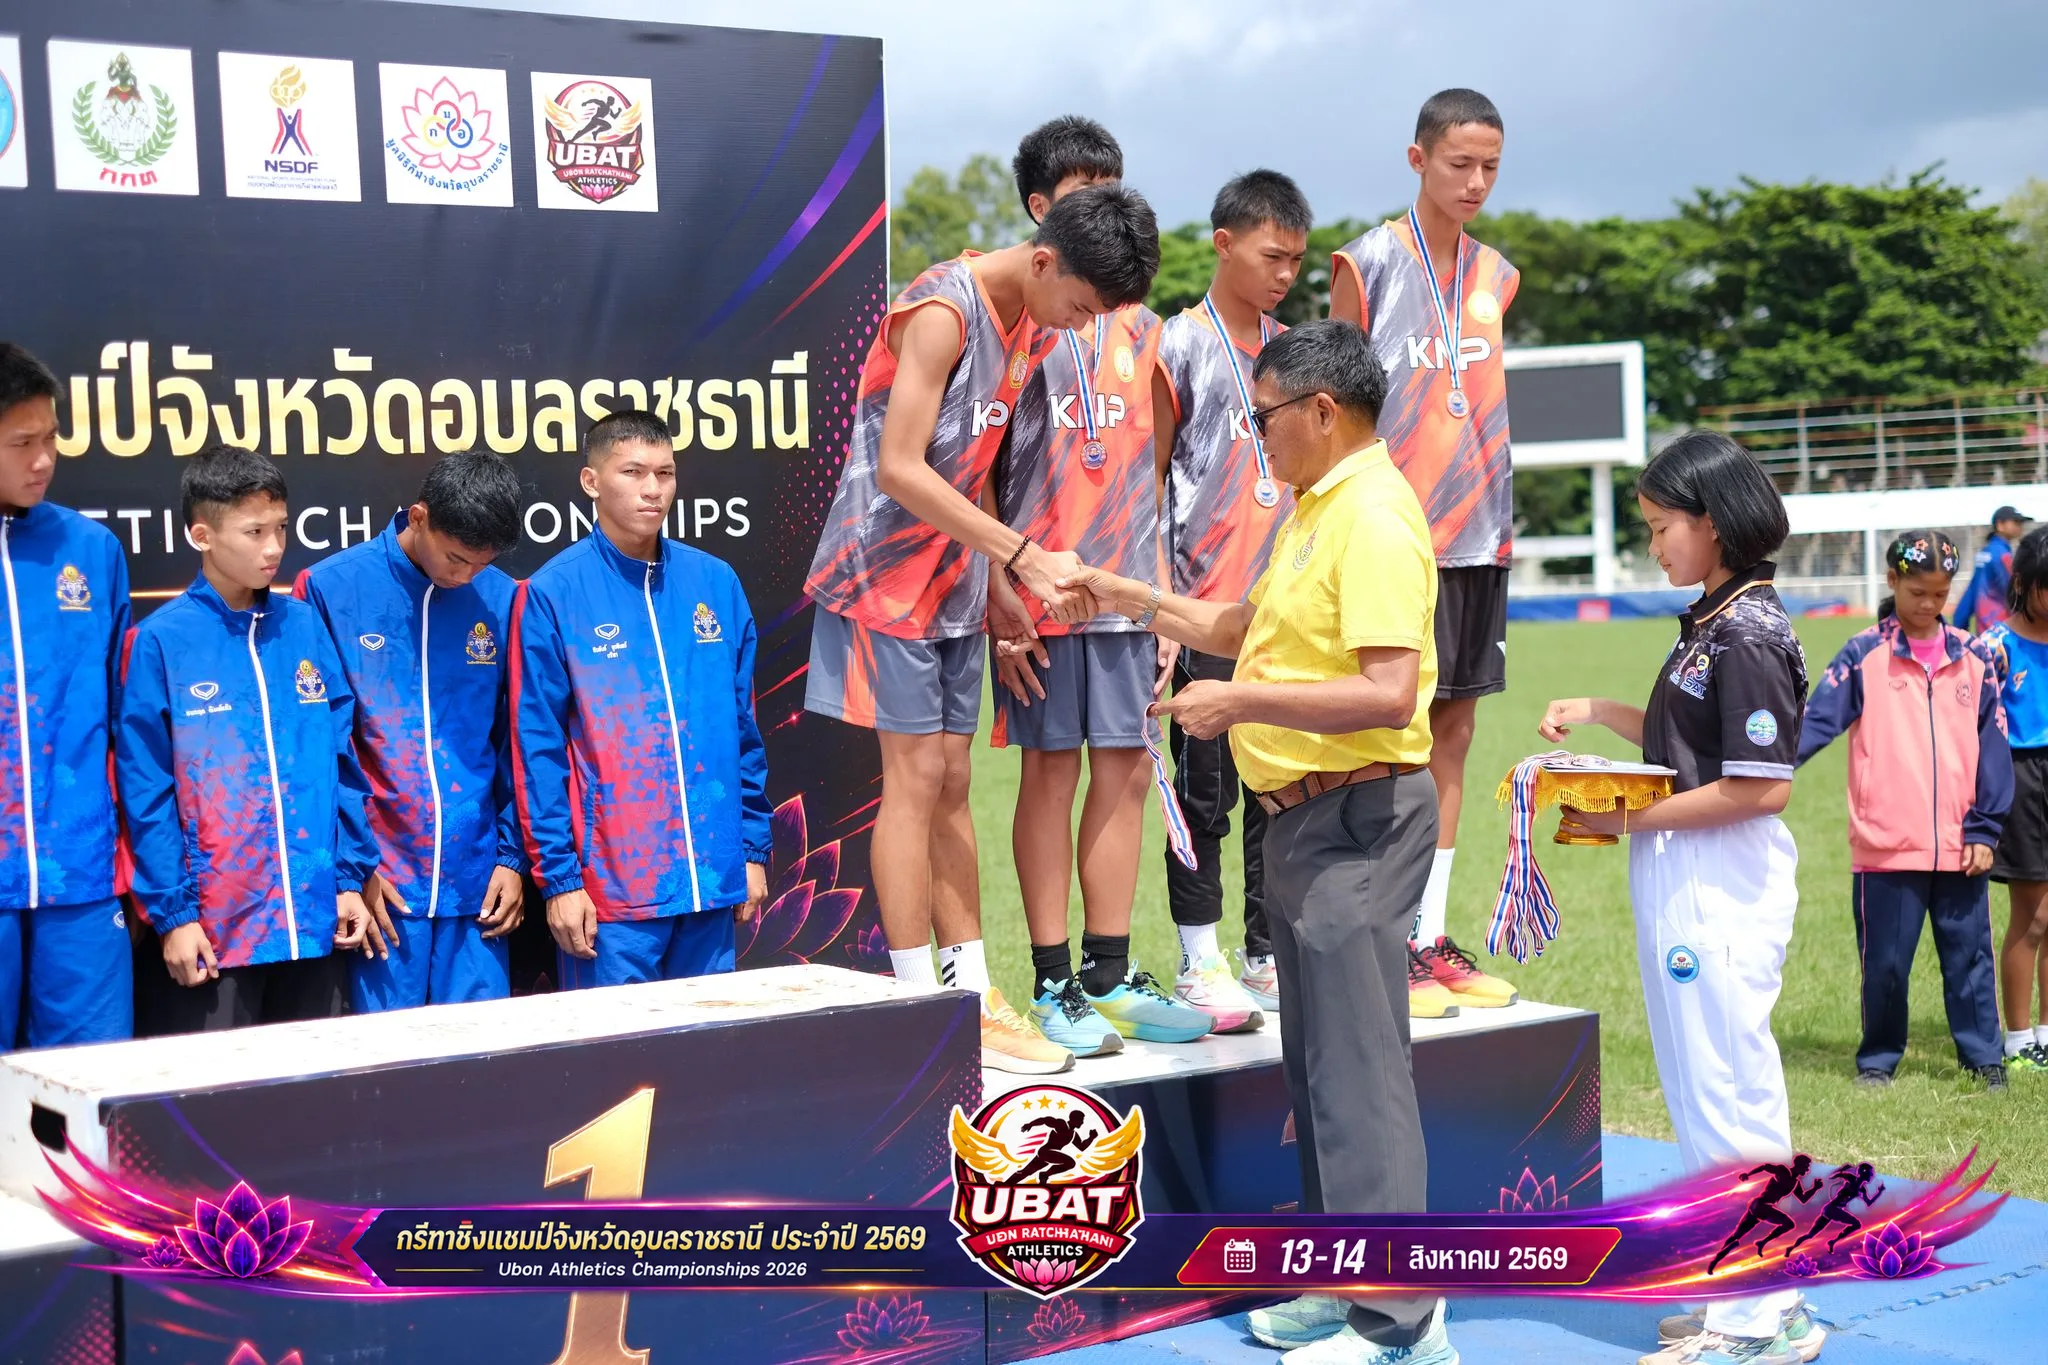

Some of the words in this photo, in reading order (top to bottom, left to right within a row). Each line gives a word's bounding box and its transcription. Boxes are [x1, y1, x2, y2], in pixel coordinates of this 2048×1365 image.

[554, 143, 637, 168] UBAT
[264, 160, 318, 174] NSDF
[99, 167, 158, 187] กกท
[577, 176, 618, 185] ATHLETICS
